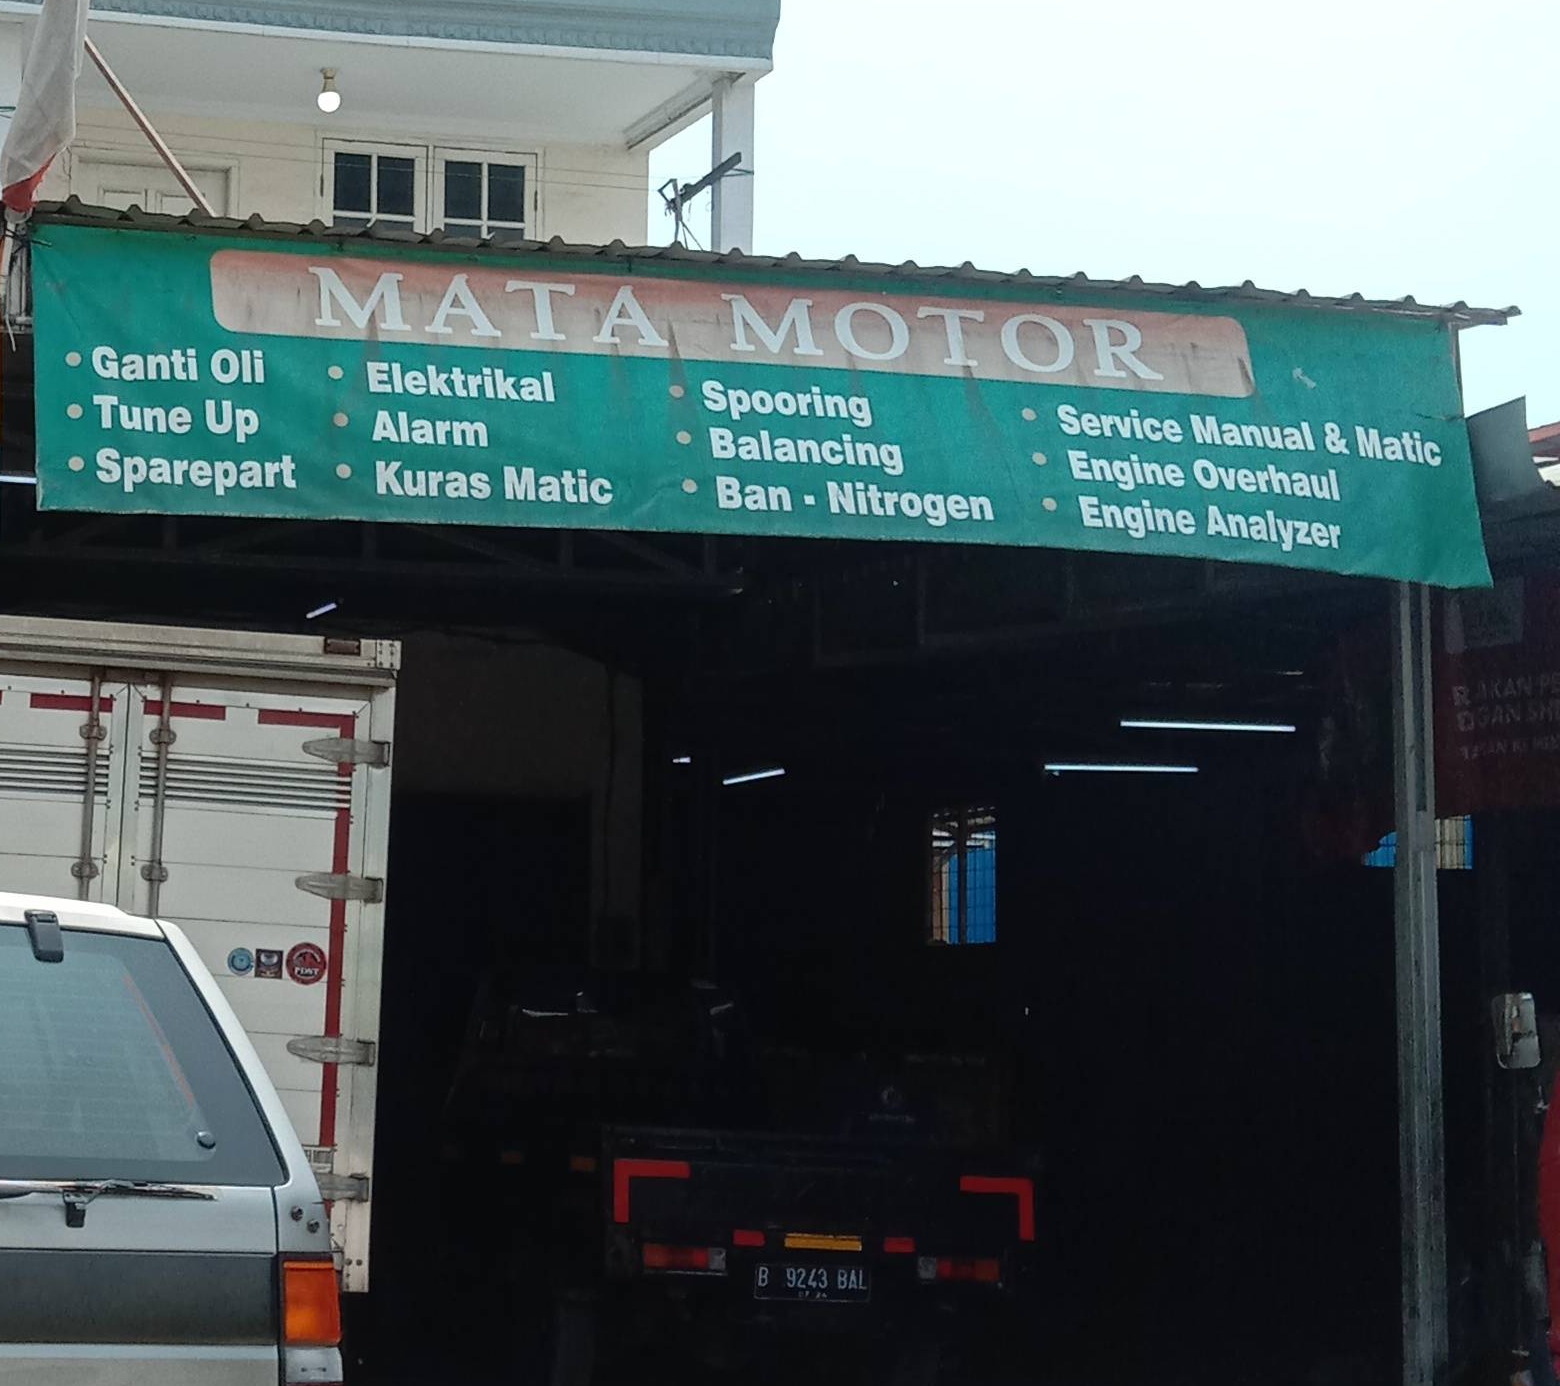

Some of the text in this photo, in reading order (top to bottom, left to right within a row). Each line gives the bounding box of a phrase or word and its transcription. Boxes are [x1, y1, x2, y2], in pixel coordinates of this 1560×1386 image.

[308, 266, 1164, 381] MATA MOTOR
[91, 345, 266, 386] Ganti Oli
[366, 361, 555, 404] Elektrikal
[92, 395, 261, 443] Tune Up
[702, 379, 873, 429] Spooring
[371, 410, 489, 449] Alarm
[709, 428, 904, 477] Balancing
[1057, 403, 1443, 469] Service Manual & Matic
[95, 447, 297, 495] Sparepart
[375, 459, 614, 506] Kuras Matic
[1067, 448, 1341, 503] Engine Overhaul
[715, 475, 794, 515] Ban
[826, 482, 994, 528] Nitrogen
[1077, 494, 1343, 553] Engine Analyzer
[758, 1266, 868, 1291] B 9243 BAL
